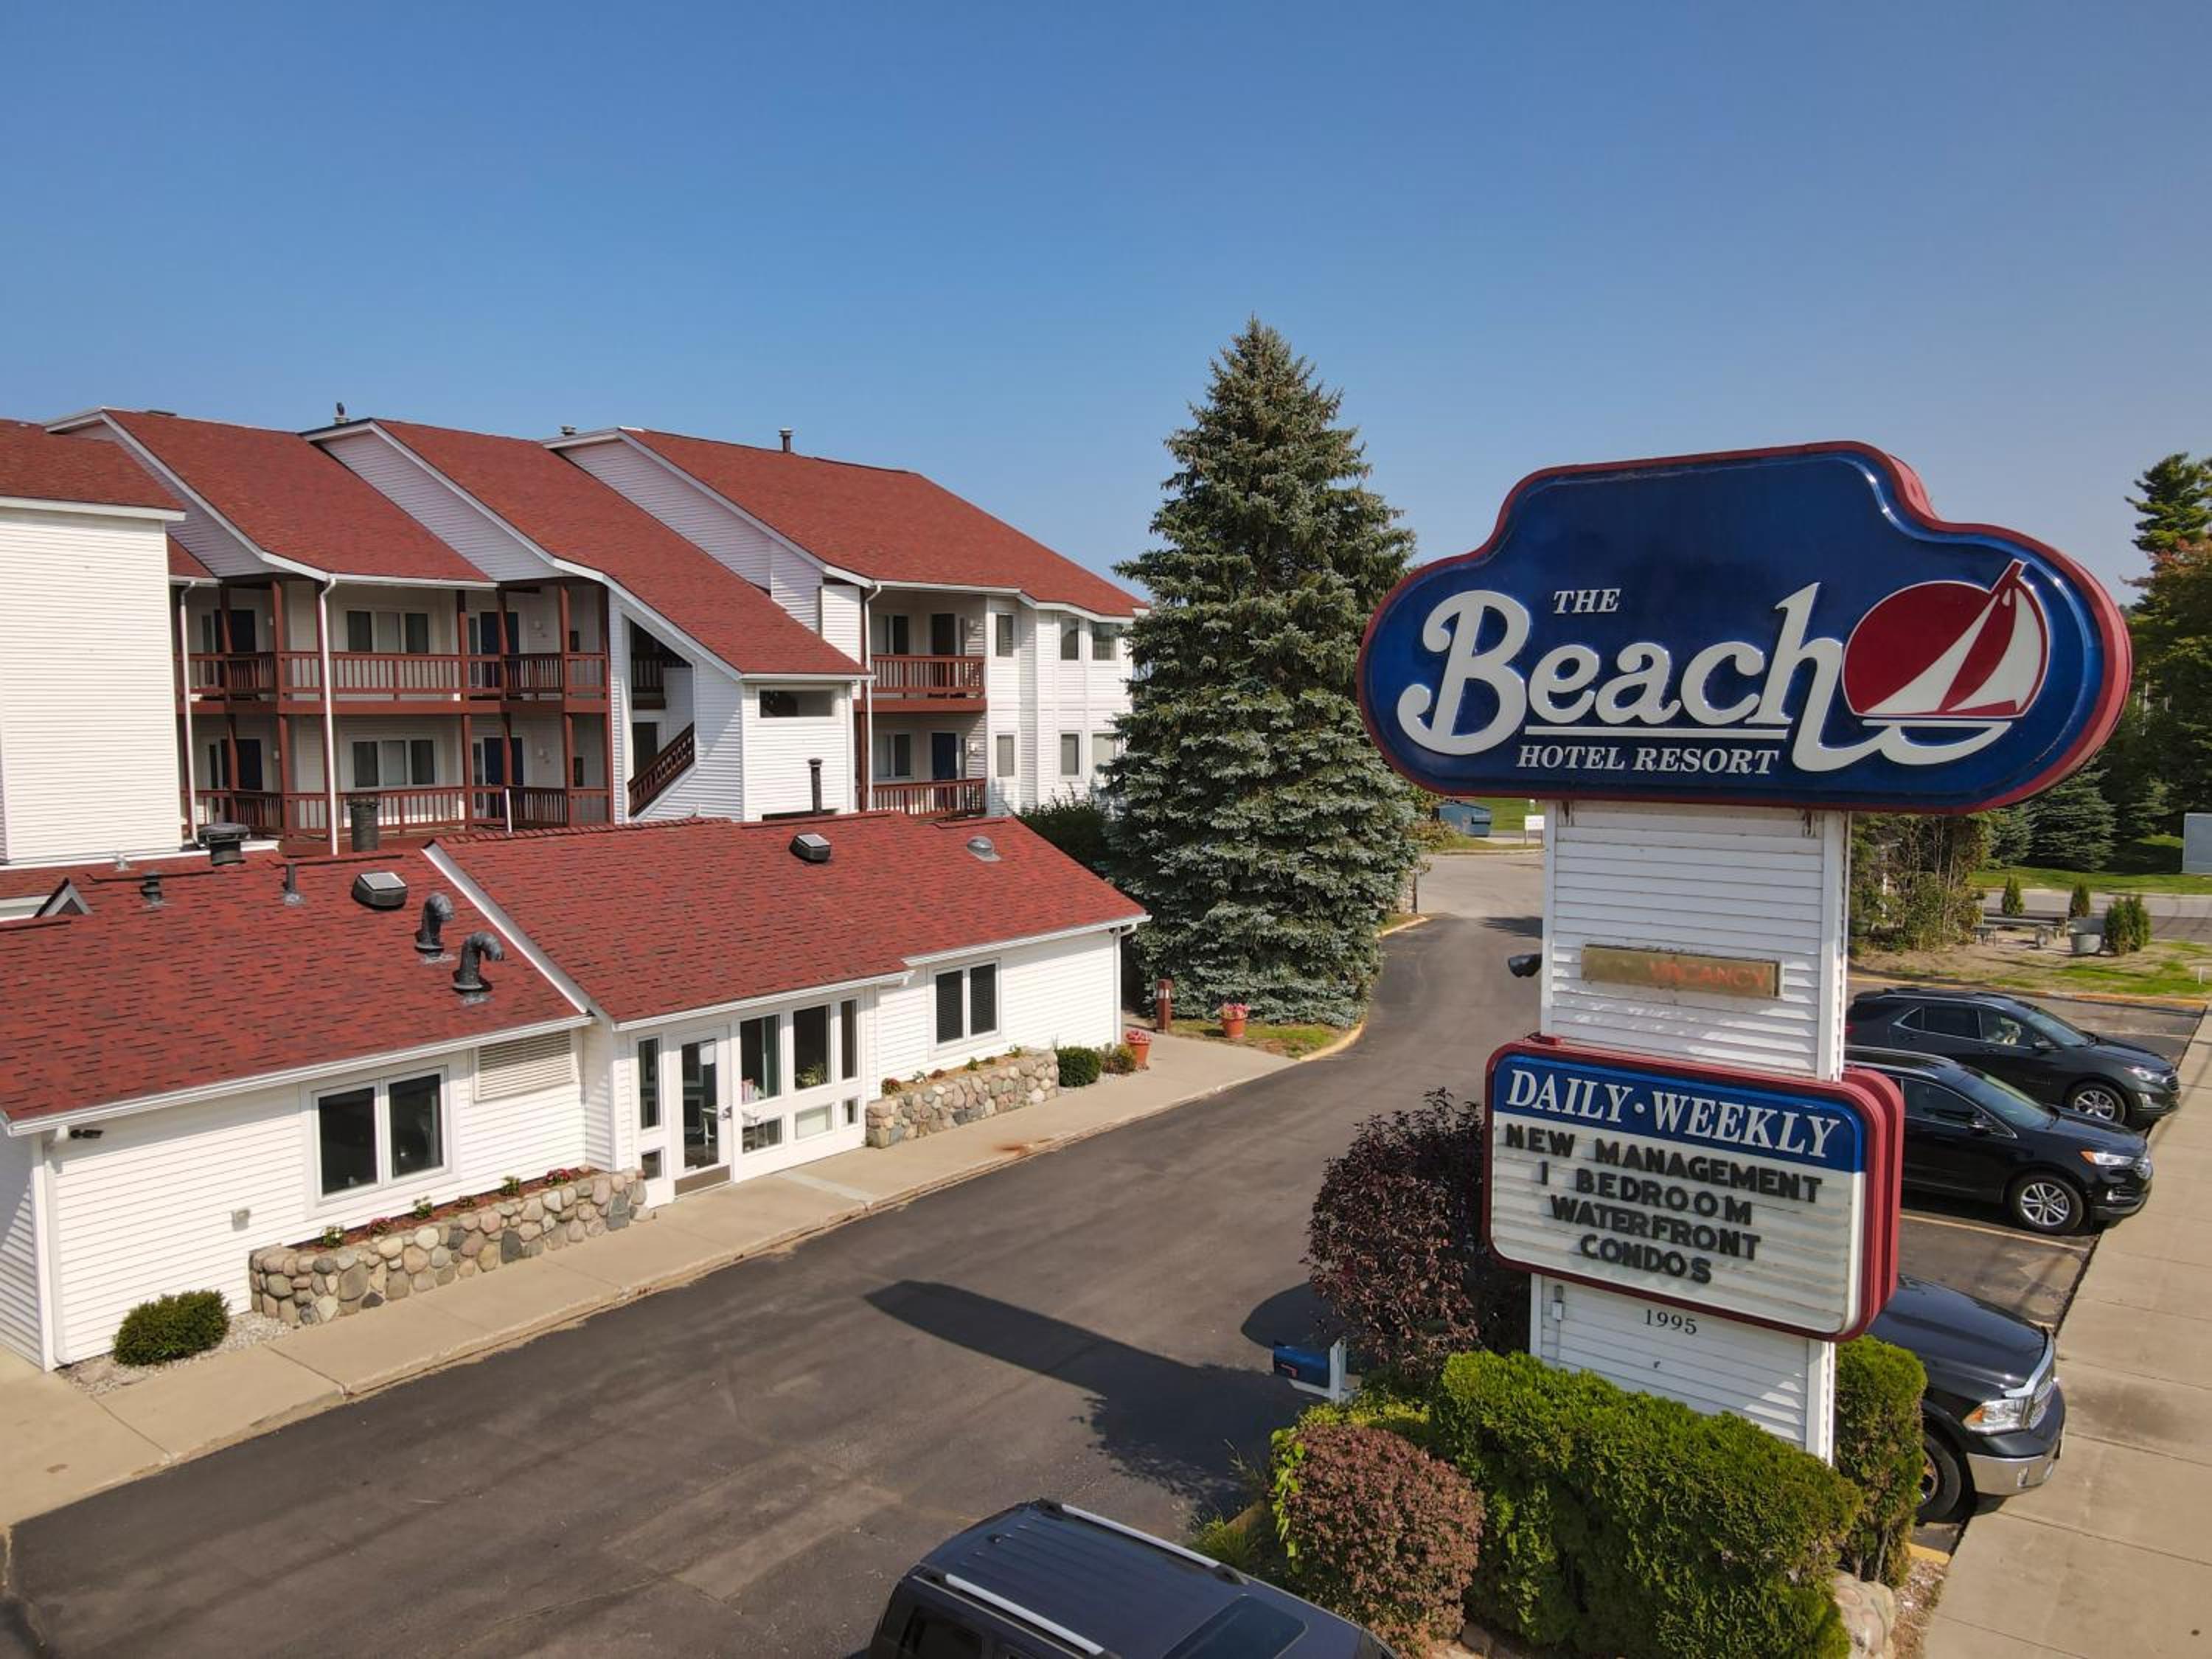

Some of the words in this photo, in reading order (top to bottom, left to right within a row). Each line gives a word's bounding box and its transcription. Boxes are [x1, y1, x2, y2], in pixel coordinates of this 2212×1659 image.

[1554, 588, 1621, 614] THE
[1397, 582, 1888, 773] Beach
[1516, 745, 1624, 769] HOTEL
[1632, 748, 1779, 774] RESORT
[1506, 1069, 1632, 1123] DAILY
[1652, 1091, 1840, 1159] WEEKLY
[1506, 1123, 1576, 1158] NEW
[1595, 1138, 1823, 1203] MANAGEMENT
[1576, 1168, 1752, 1225] BEDROOM
[1551, 1194, 1761, 1261] WATERFRONT
[1580, 1234, 1711, 1284] CONDOS
[1644, 1310, 1697, 1335] 1995
